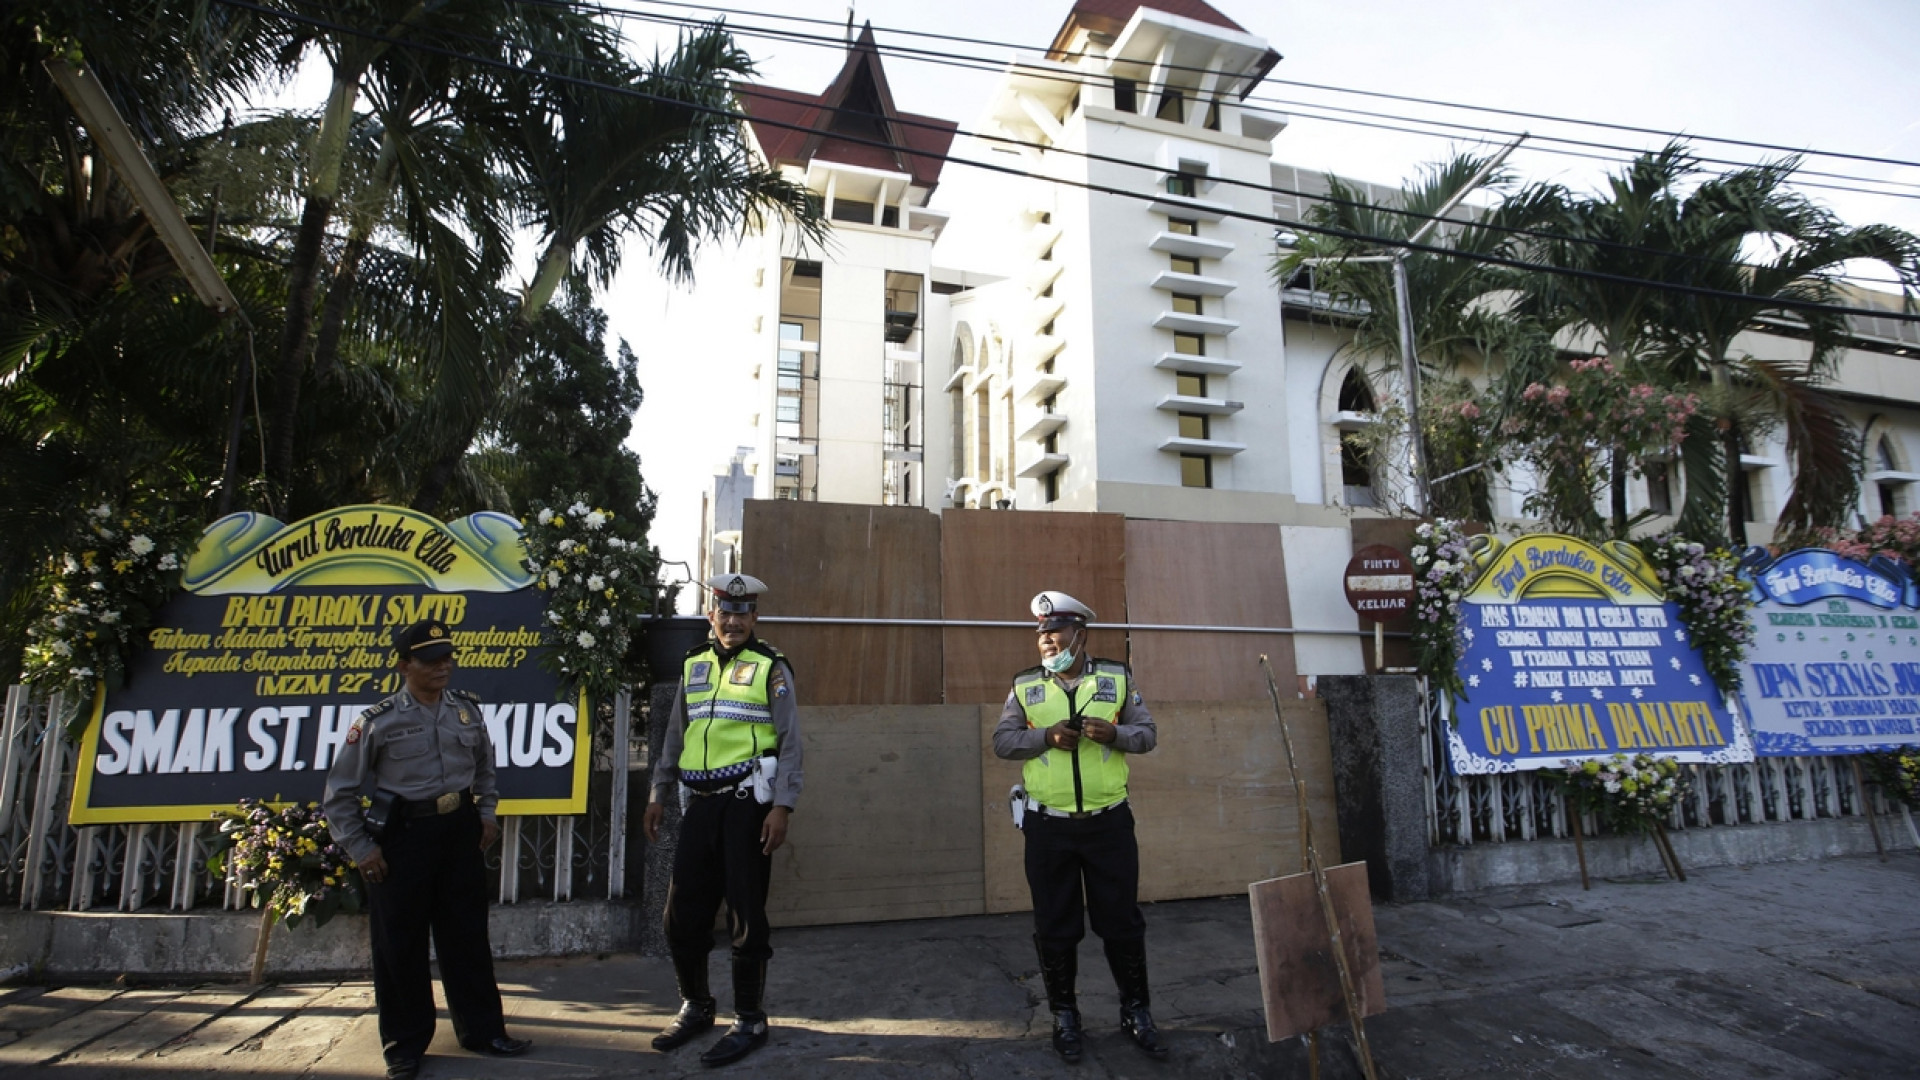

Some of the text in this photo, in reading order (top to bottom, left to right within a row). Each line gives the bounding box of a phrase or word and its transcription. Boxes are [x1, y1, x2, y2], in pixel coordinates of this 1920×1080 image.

[257, 519, 320, 577] Turut
[324, 513, 416, 552] Berduka
[1363, 559, 1400, 570] PINTU
[221, 594, 467, 628] BAGI PAROKI SMTB
[1357, 598, 1406, 610] KELUAR
[149, 627, 211, 649] Tuhan
[214, 626, 287, 649] Adalah
[288, 625, 377, 653] Terangku
[163, 650, 241, 678] Kepada
[339, 648, 384, 669] Aku
[256, 674, 332, 696] (MZM
[1567, 671, 1616, 687] HARGA
[1751, 662, 1803, 698] DPN
[1804, 662, 1891, 697] SEKNAS
[96, 707, 243, 775] SMAK
[244, 705, 311, 772] ST.
[1480, 701, 1726, 756] CU PRIMA DANARTA
